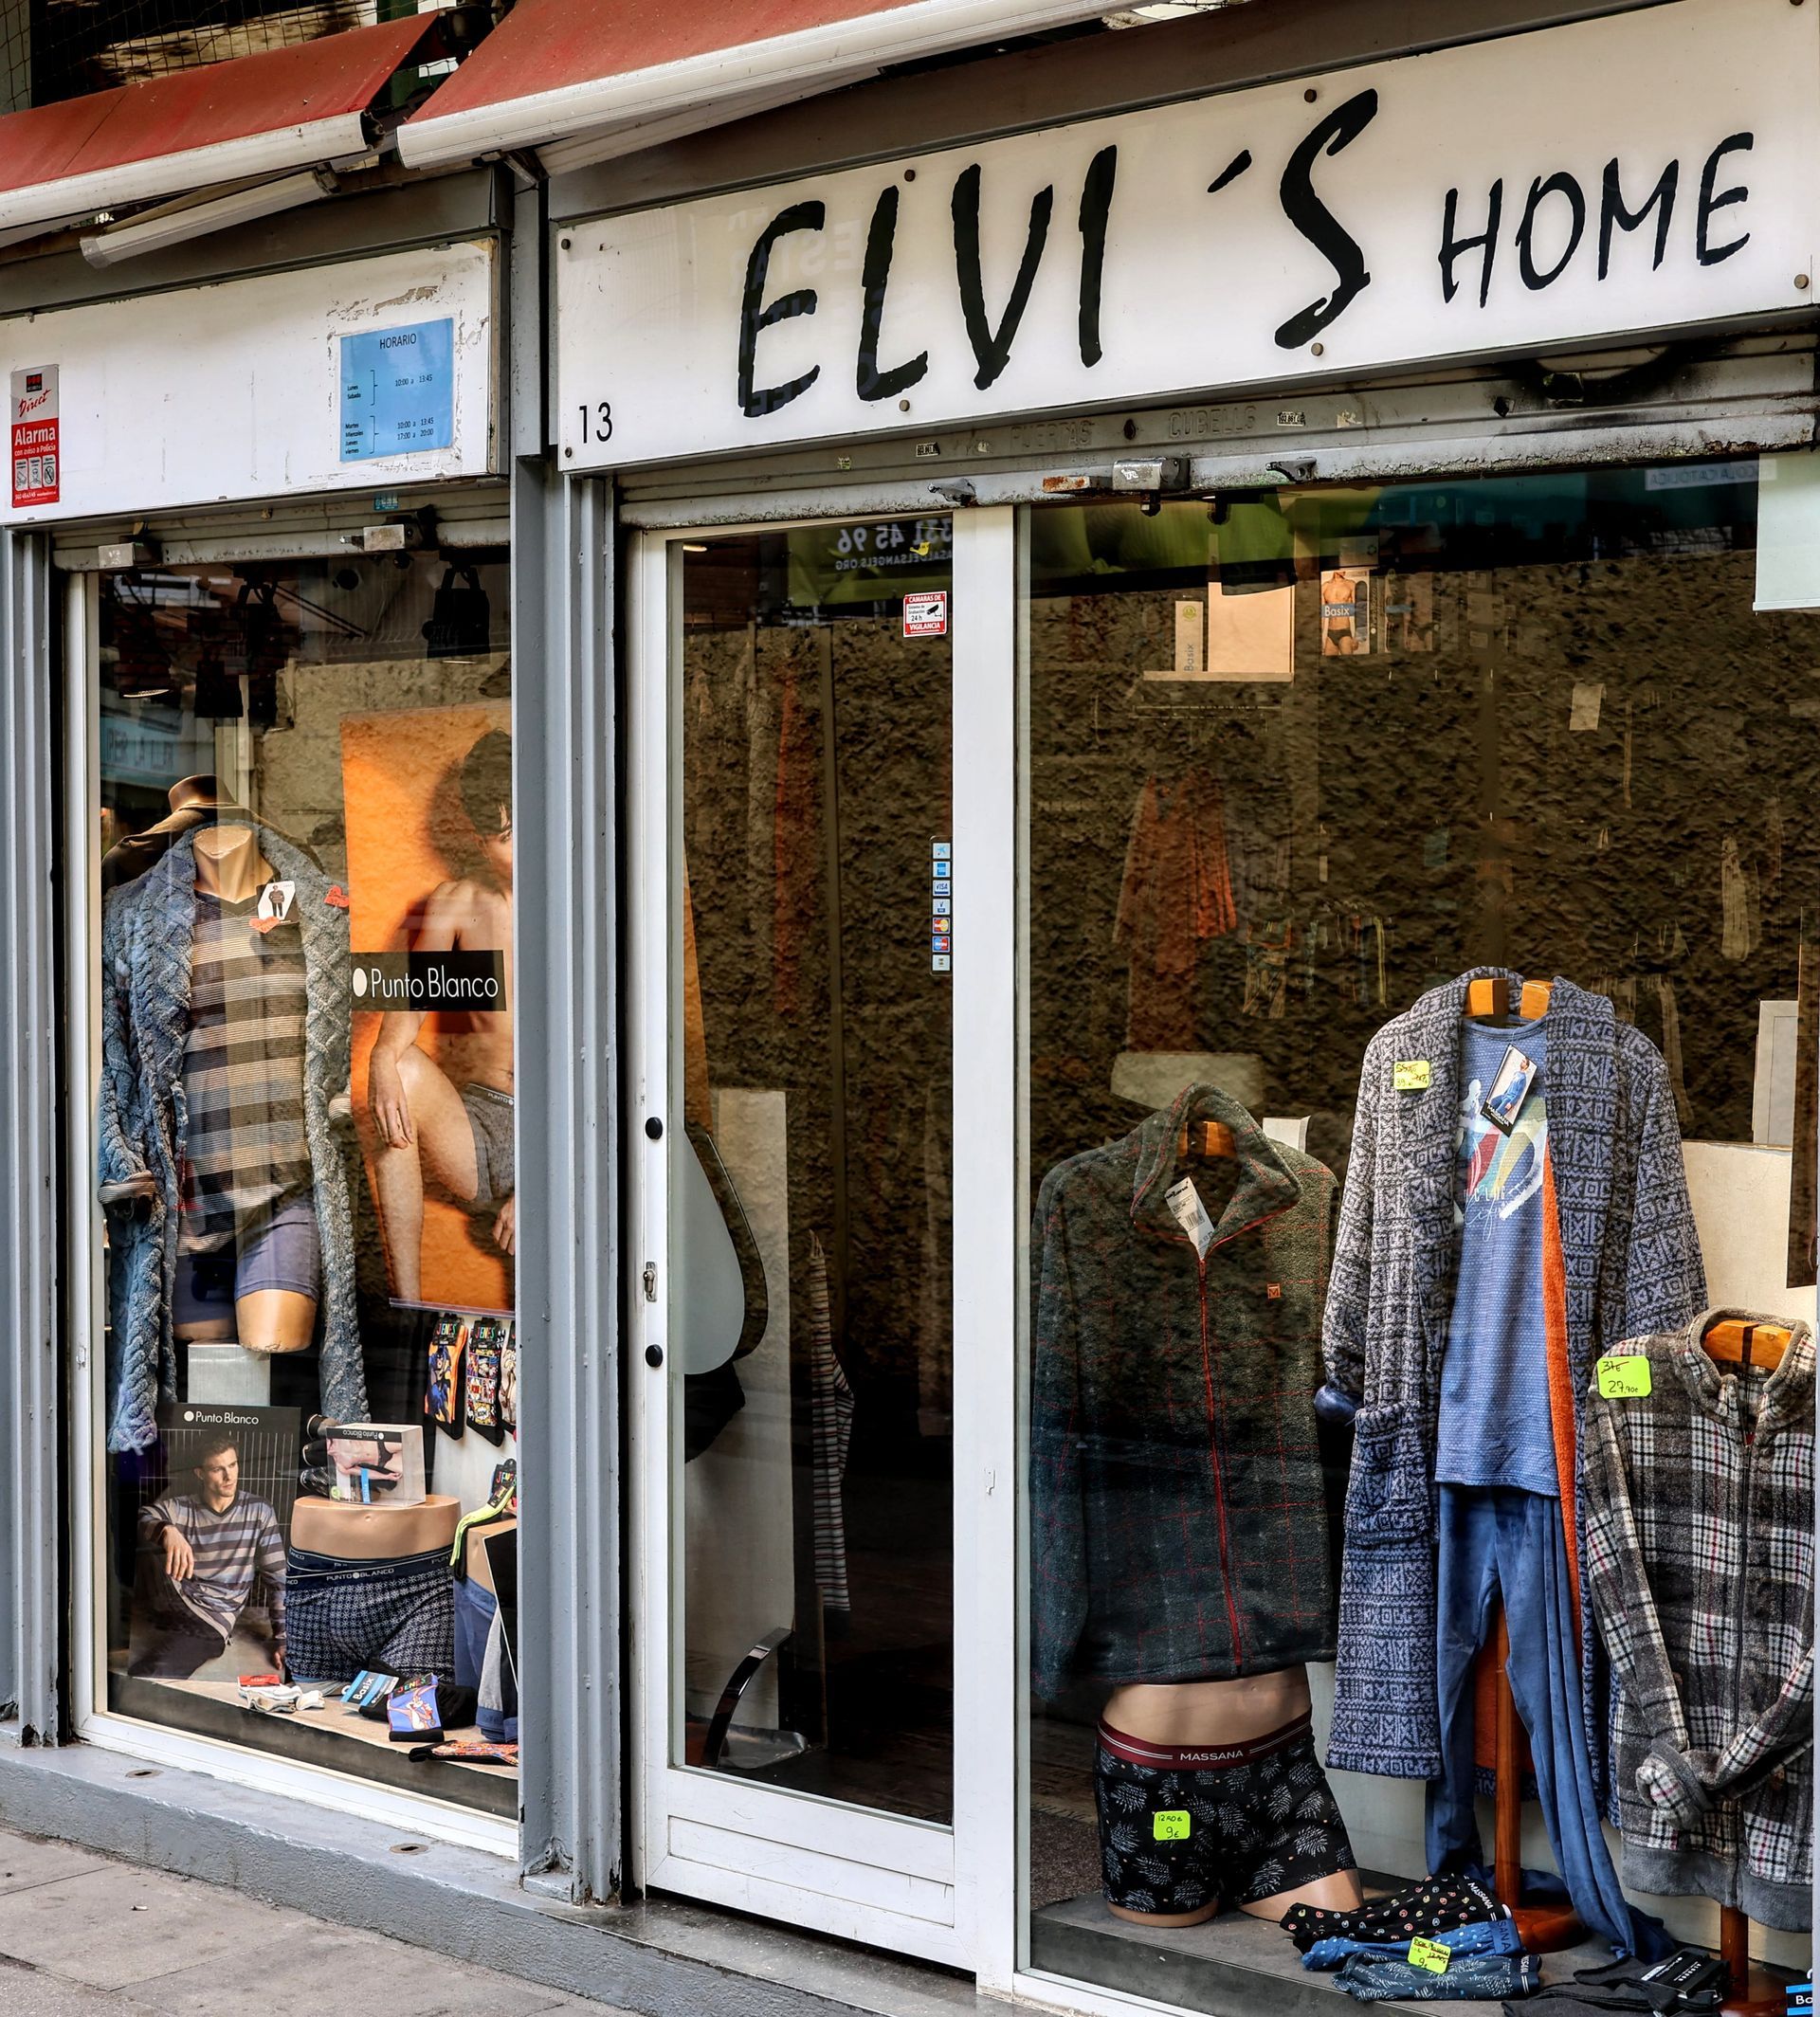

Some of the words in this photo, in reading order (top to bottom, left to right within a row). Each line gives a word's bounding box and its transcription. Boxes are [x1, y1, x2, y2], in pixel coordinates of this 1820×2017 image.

[1438, 132, 1754, 308] HOME
[380, 333, 417, 350] HORARIO
[19, 389, 51, 418] Direct
[579, 401, 613, 445] 13
[14, 427, 56, 446] Alarma
[1323, 605, 1351, 617] Basix
[909, 622, 941, 630] VIGILANCIA
[1183, 644, 1194, 671] Basix
[371, 968, 424, 998] Punto
[428, 964, 499, 998] Blanco
[437, 1323, 457, 1336] JENES
[475, 1326, 495, 1338] JENES
[195, 1410, 223, 1424] Punto
[224, 1411, 259, 1425] Blanco
[326, 1572, 354, 1582] PUNTO
[360, 1568, 394, 1578] BLANCO
[353, 1677, 374, 1700] Basix
[397, 1678, 426, 1694] JENES
[1179, 1750, 1244, 1761] MASSANA
[1467, 1881, 1494, 1910] MASSANA
